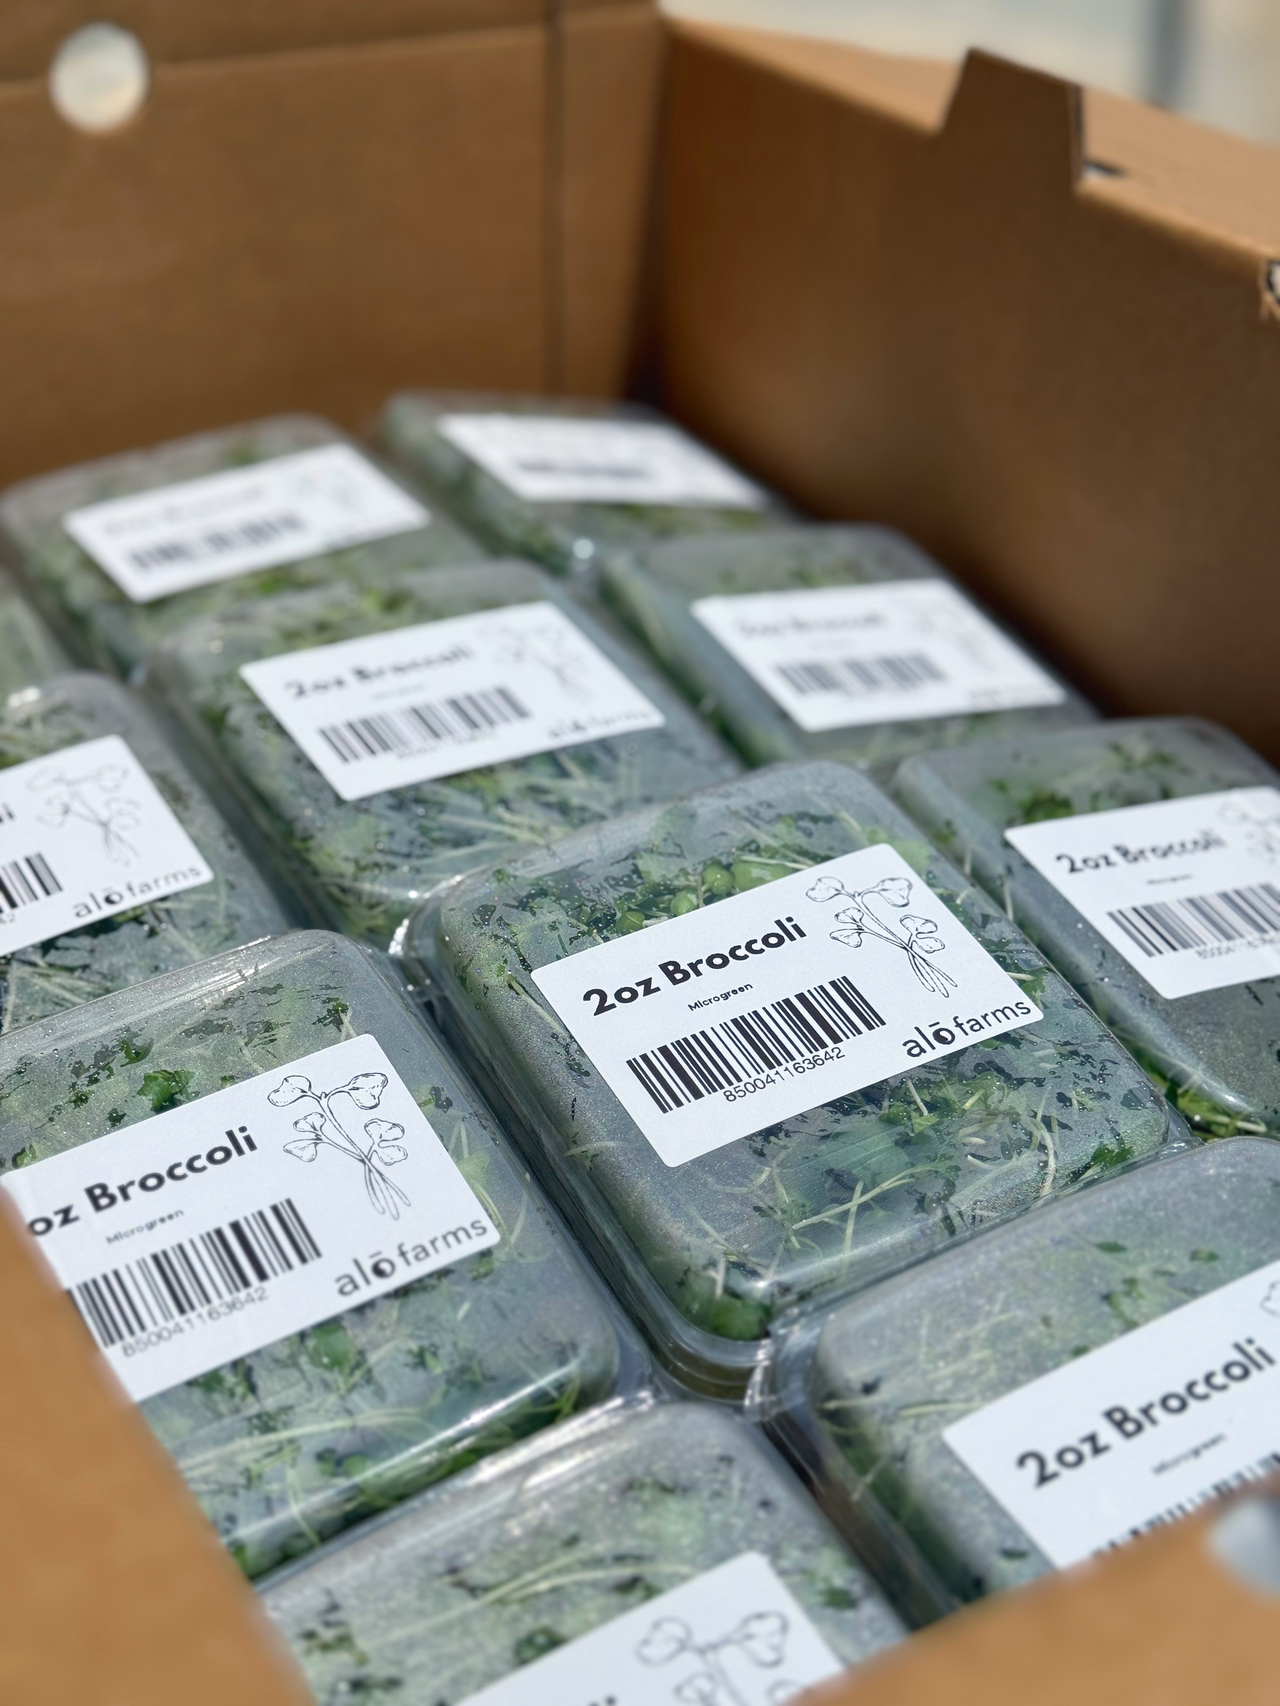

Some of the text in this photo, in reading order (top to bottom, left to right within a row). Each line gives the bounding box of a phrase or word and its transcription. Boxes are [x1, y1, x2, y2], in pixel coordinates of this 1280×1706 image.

[1055, 828, 1228, 874] 2oz Broccoli
[126, 865, 202, 897] farms
[582, 916, 807, 1017] 2oz Broccoli
[687, 983, 754, 1012] Microgreen
[952, 1001, 1031, 1037] farms
[723, 1046, 846, 1102] 850041163642
[28, 1125, 258, 1237] oz Broccoli
[106, 1209, 185, 1245] Microgreen
[397, 1218, 489, 1267] farms
[121, 1286, 269, 1358] 850041163642
[1016, 1336, 1276, 1489] 2oz Broccoli
